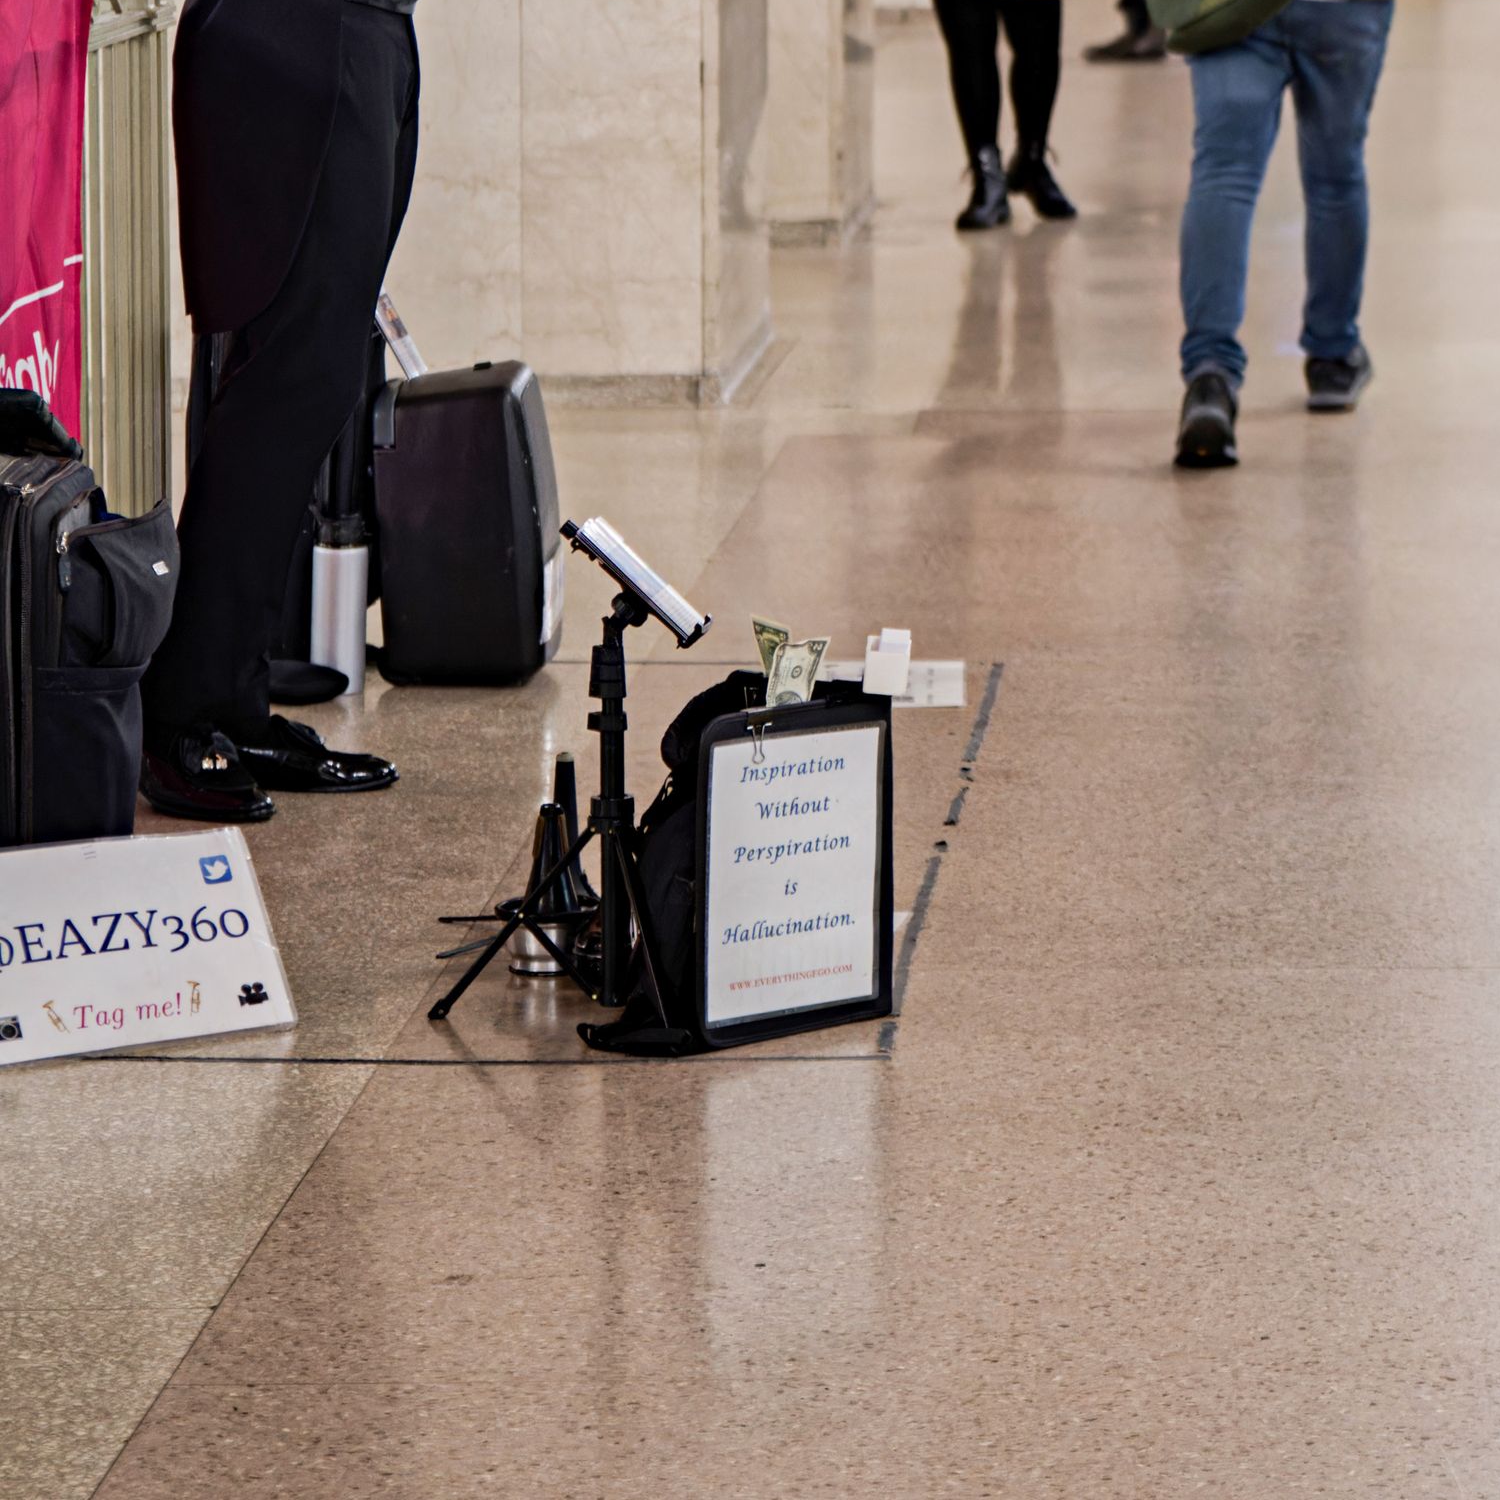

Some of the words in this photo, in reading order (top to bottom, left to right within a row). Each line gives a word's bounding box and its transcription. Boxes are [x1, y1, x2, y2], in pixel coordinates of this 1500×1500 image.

[739, 756, 845, 787] Inspiration
[755, 795, 831, 821] Without
[733, 833, 851, 865] Perspiration
[784, 878, 798, 896] is
[721, 911, 856, 946] Hallucination.
[73, 1003, 125, 1031] Tag
[135, 992, 182, 1022] me!
